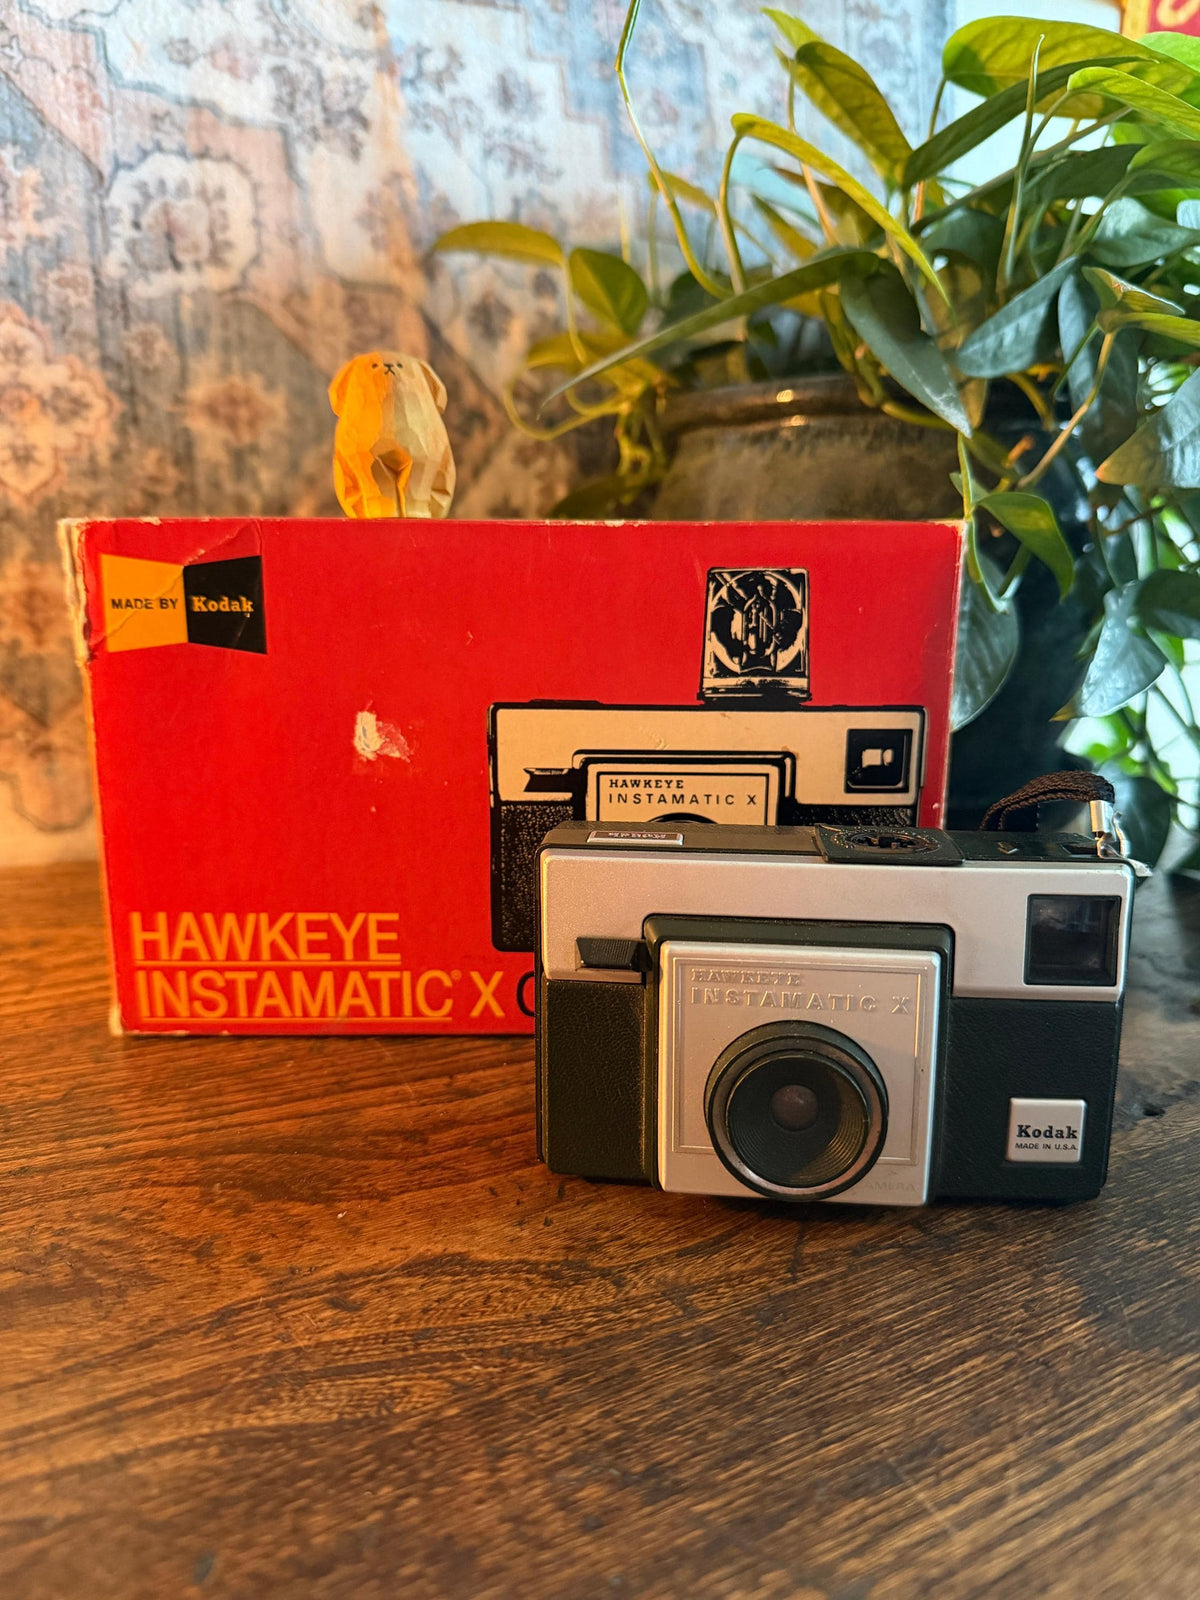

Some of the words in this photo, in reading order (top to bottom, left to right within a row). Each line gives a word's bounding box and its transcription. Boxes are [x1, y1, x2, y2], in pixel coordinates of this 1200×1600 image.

[111, 598, 154, 610] MADE
[159, 598, 179, 610] BY
[190, 595, 255, 613] Kodak
[608, 778, 685, 790] HAWKEYE
[608, 792, 736, 806] INSTAMATIC
[746, 793, 757, 806] X
[129, 911, 400, 961] HAWKEYE
[690, 967, 801, 986] HAWKEYE
[136, 969, 454, 1019] INSTAMATIC
[469, 970, 506, 1018] X
[690, 986, 878, 1012] INSTAMATIC
[891, 994, 911, 1014] X
[1016, 1124, 1078, 1139] Kodak
[1014, 1142, 1040, 1150] MADE
